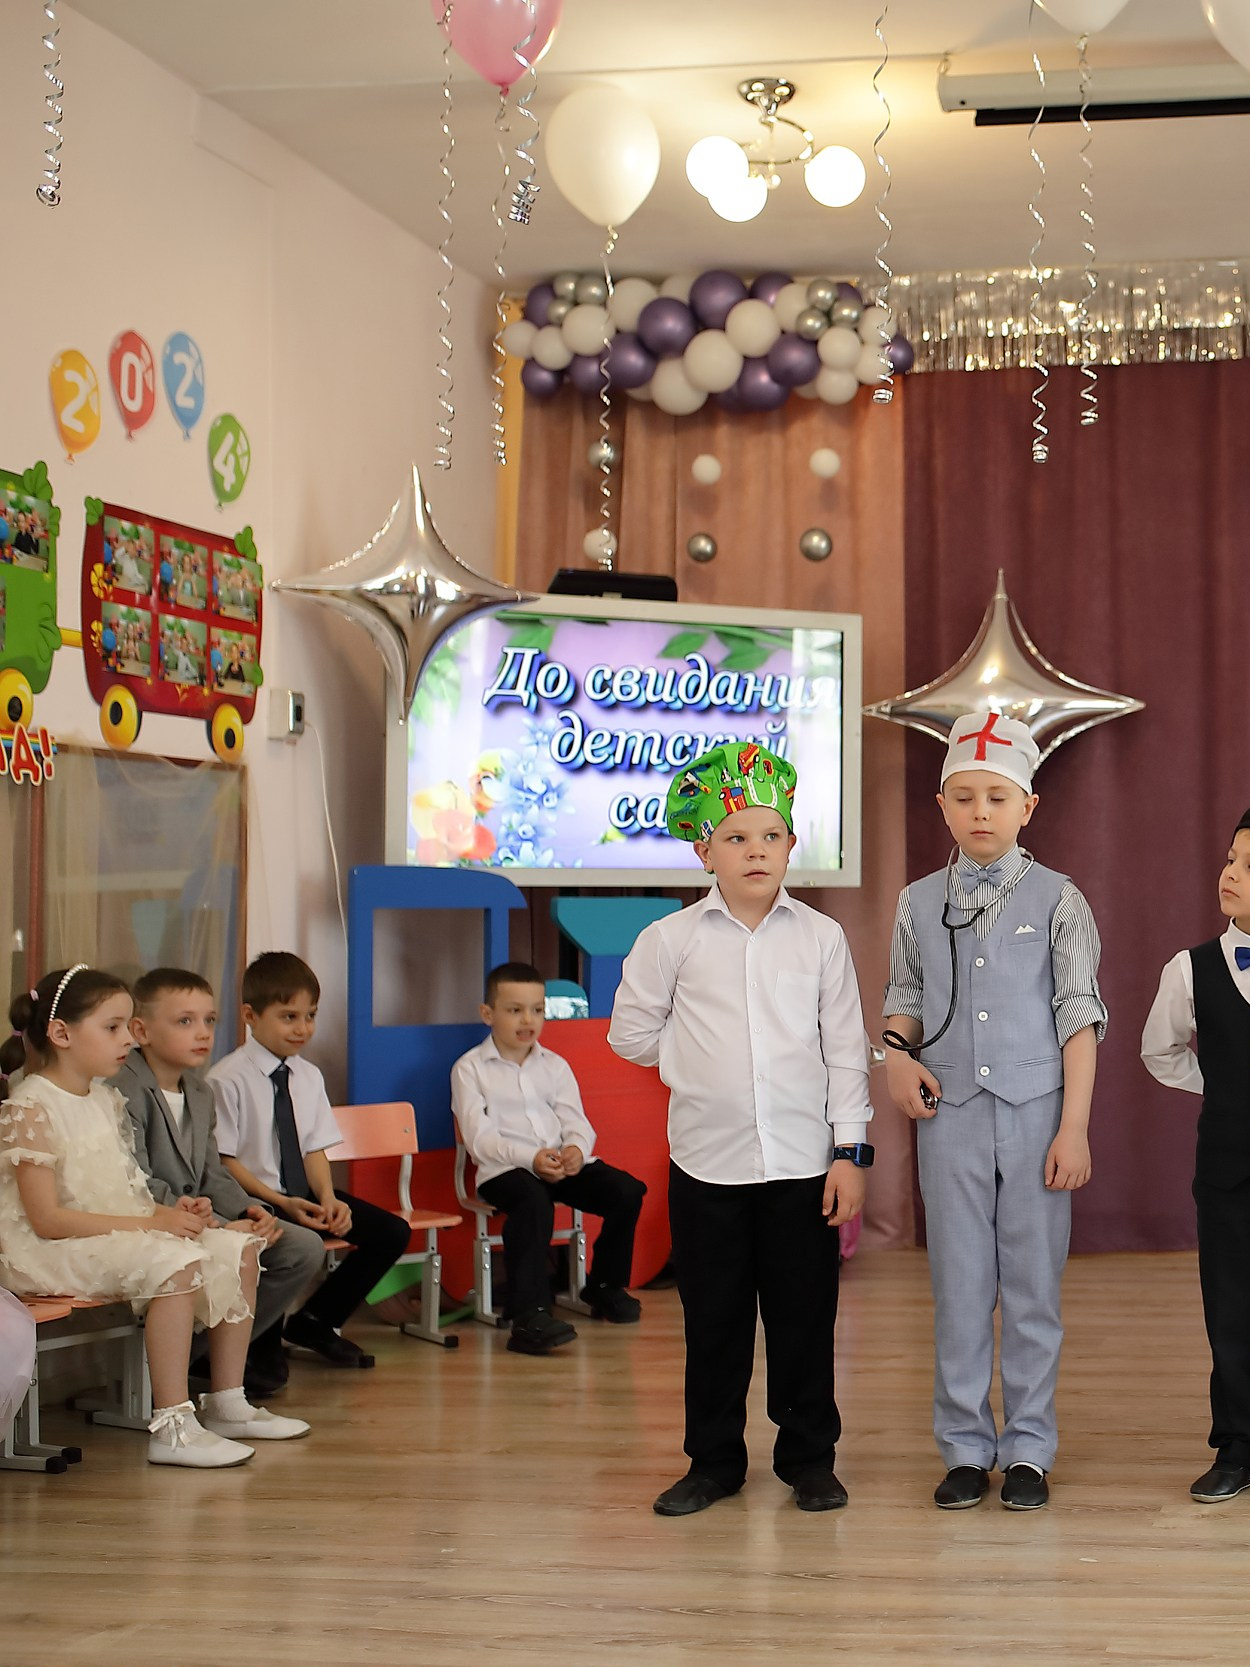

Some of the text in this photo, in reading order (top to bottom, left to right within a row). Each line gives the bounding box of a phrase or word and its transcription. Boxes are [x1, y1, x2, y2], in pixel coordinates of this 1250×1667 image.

[482, 646, 836, 711] До свидания
[609, 792, 670, 832] са
